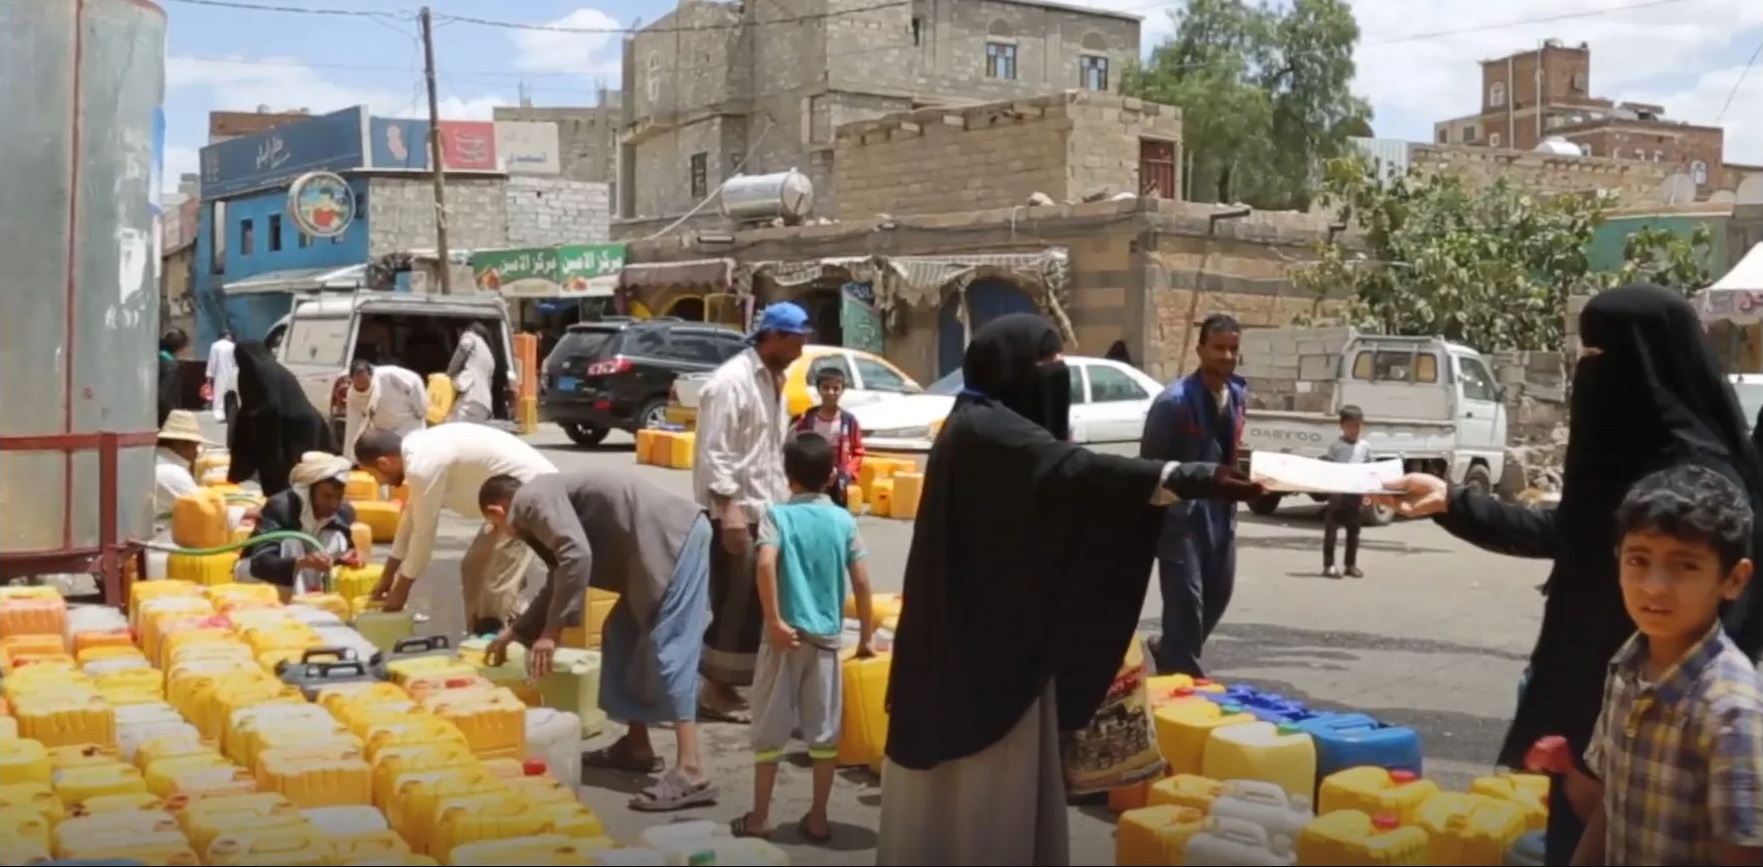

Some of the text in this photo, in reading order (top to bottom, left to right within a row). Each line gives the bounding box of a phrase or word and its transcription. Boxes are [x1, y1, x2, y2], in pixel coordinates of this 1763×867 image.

[532, 252, 557, 275] مركز
[597, 250, 623, 274] مركز
[1250, 428, 1322, 442] DAEWOO
